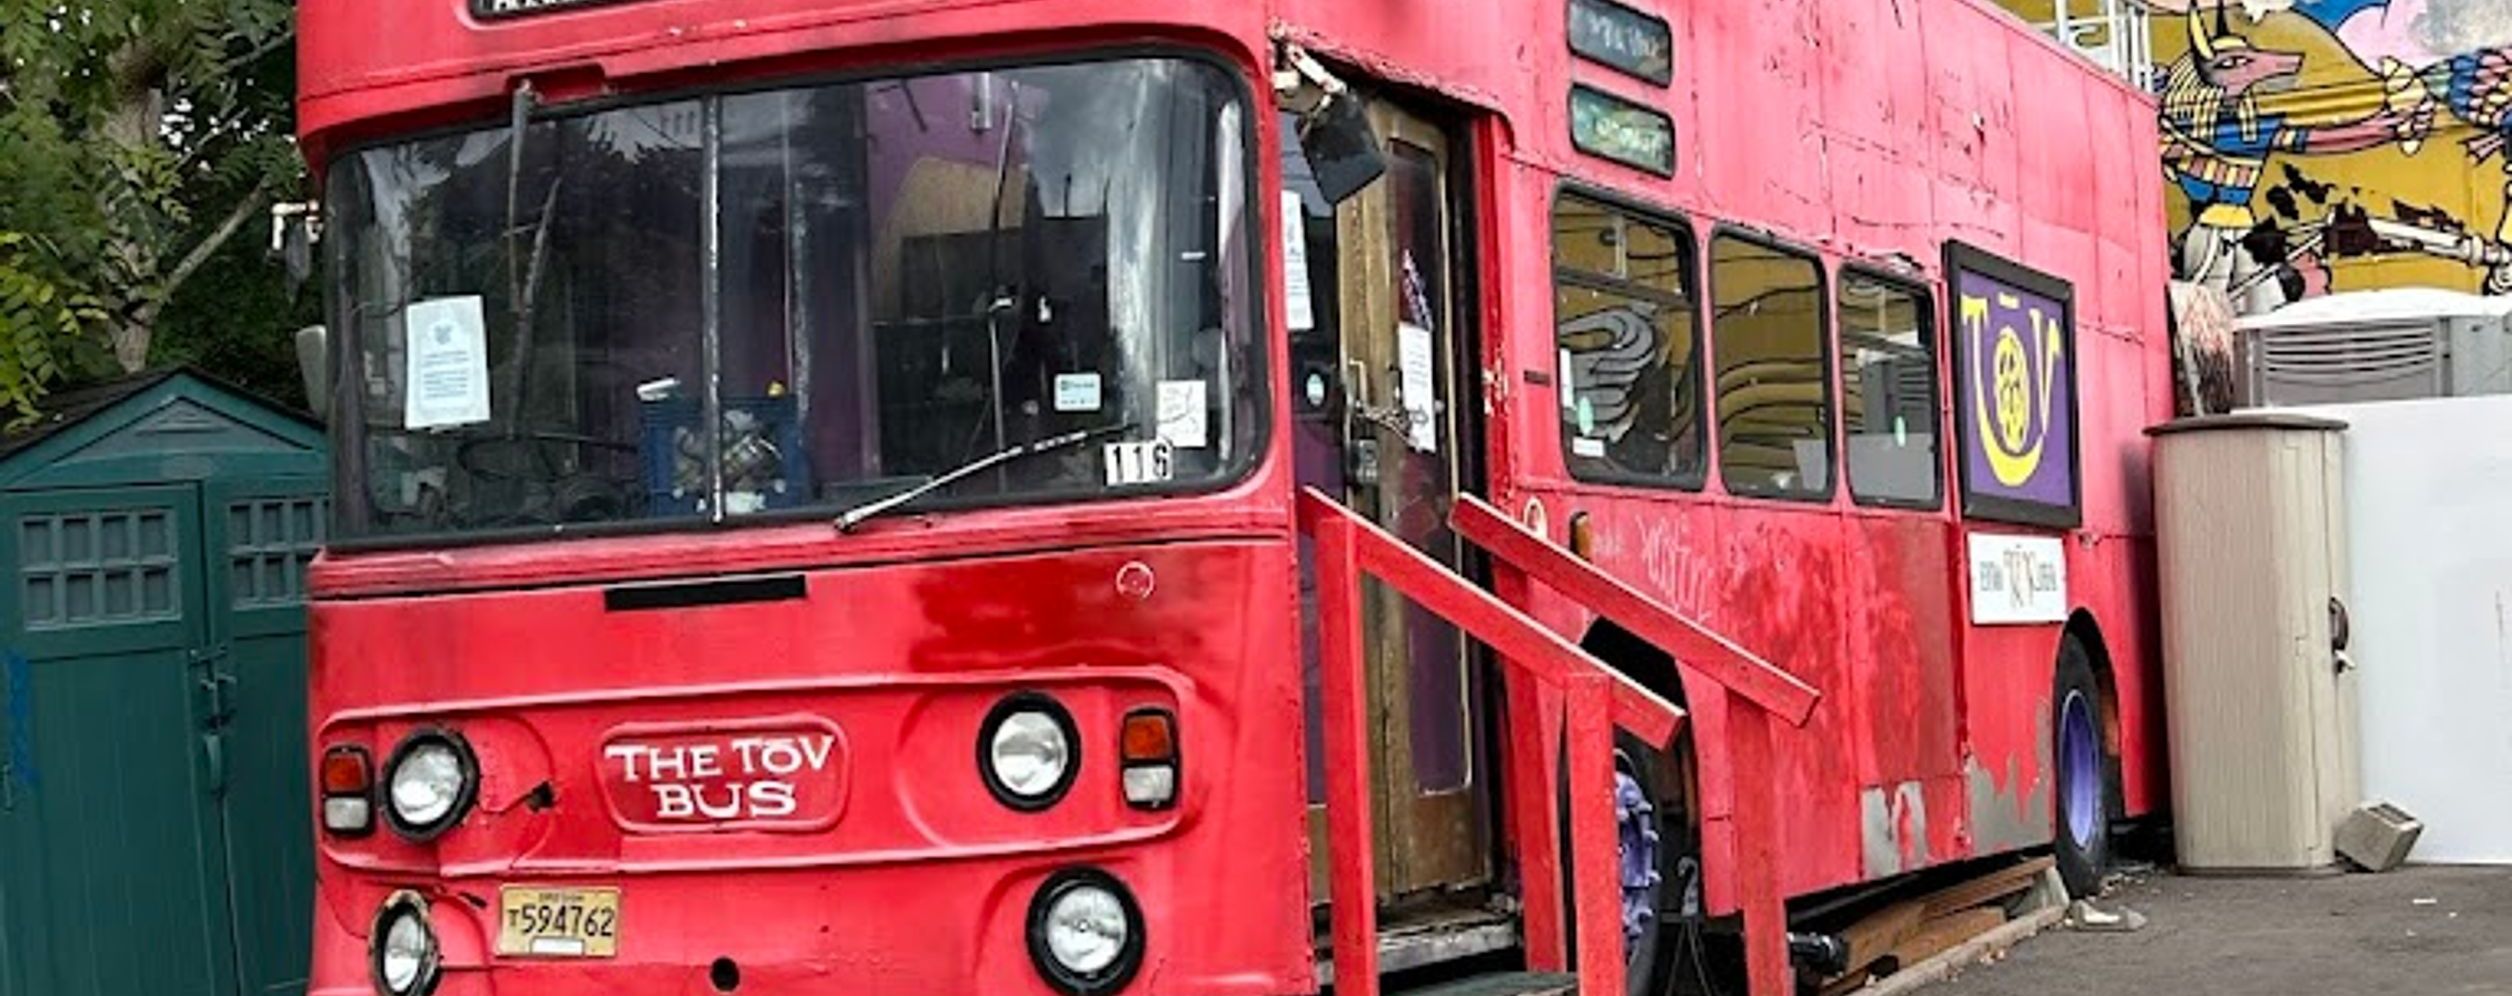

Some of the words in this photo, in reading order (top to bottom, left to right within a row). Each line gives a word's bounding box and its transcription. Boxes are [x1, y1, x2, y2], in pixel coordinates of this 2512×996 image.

[1113, 444, 1168, 481] 116
[604, 745, 723, 782] THE
[651, 780, 796, 818] BUS
